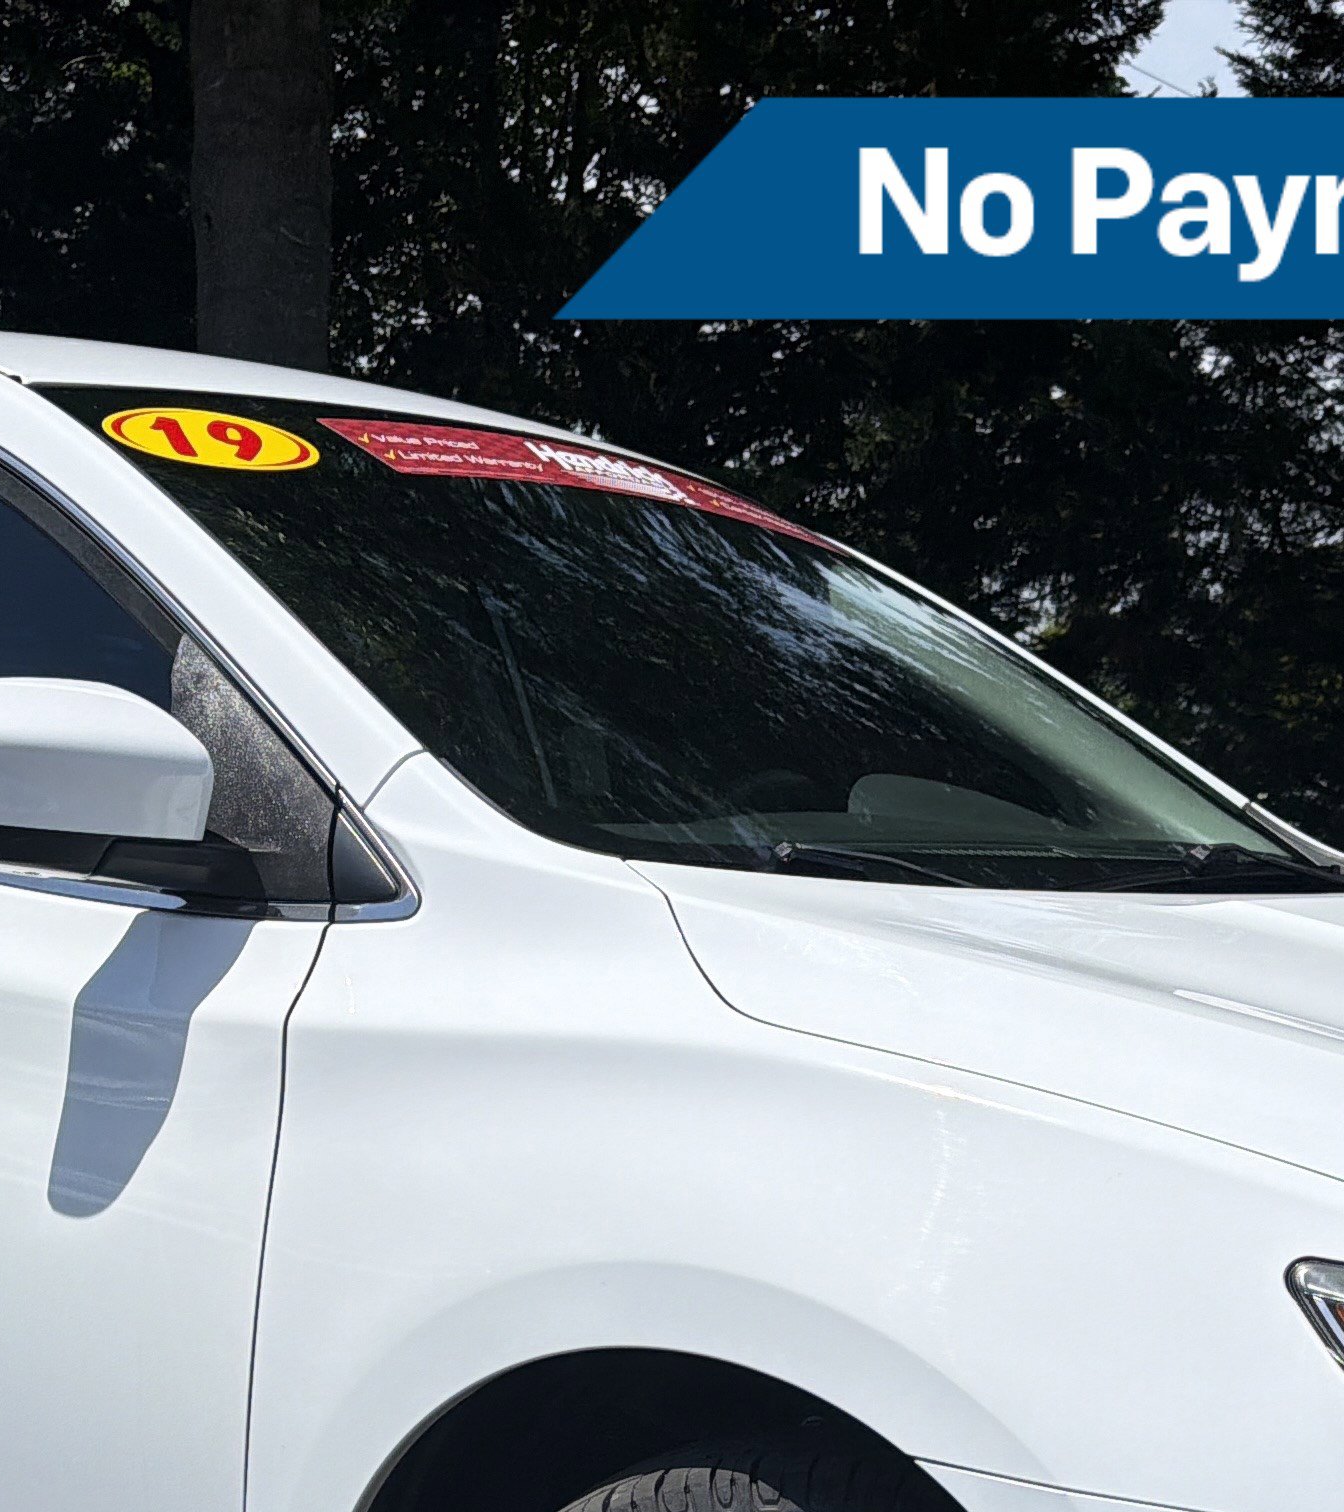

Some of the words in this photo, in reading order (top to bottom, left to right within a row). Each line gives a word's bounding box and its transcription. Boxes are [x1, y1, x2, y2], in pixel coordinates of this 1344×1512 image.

[150, 417, 263, 462] 19
[370, 433, 423, 446] Value
[423, 436, 481, 450] Priced
[397, 450, 464, 464] Limited
[464, 454, 544, 473] Warranty
